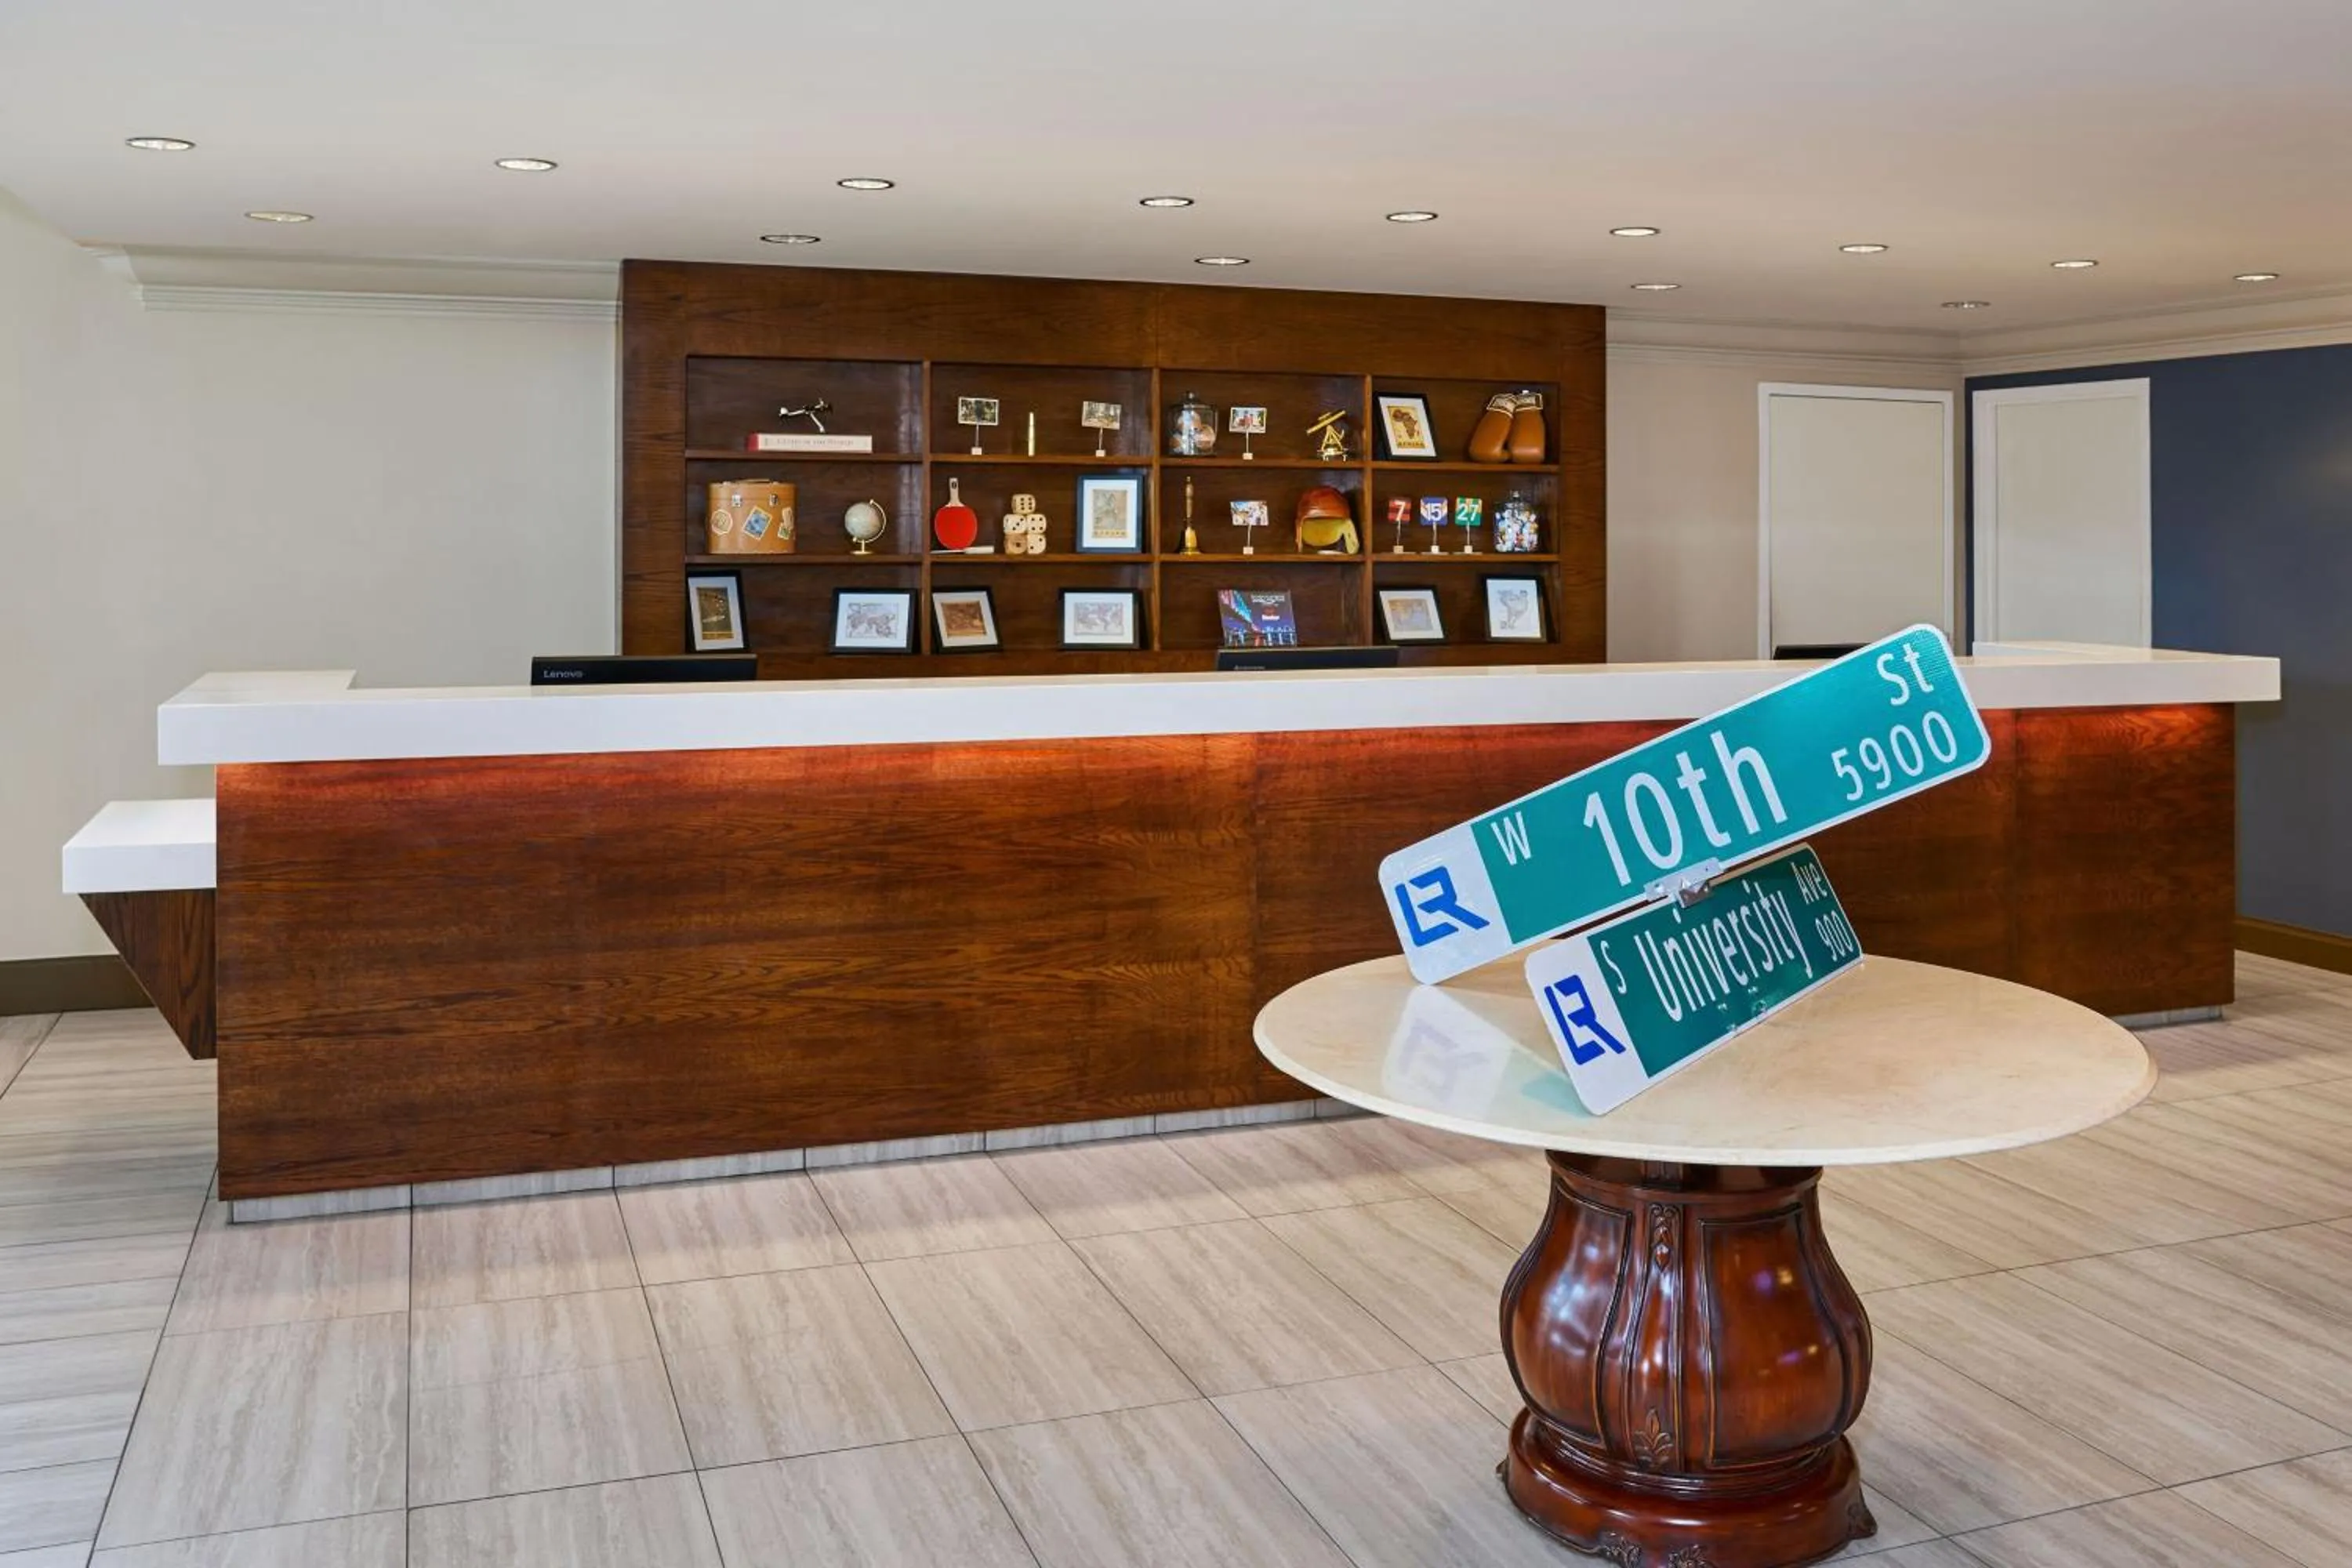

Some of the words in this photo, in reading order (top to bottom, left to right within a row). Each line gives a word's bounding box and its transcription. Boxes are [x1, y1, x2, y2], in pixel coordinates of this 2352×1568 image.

[1395, 500, 1405, 521] 7
[1424, 503, 1443, 521] 15
[1457, 503, 1479, 521] 27
[543, 669, 583, 678] Lenovo
[1492, 812, 1530, 865] W
[1584, 731, 1787, 886] 10th
[1877, 643, 1933, 705] St
[1832, 711, 1957, 800] 5900
[1600, 940, 1627, 994] S
[1634, 879, 1813, 1022] University
[1791, 862, 1828, 905] Ave
[1815, 910, 1854, 962] 900
